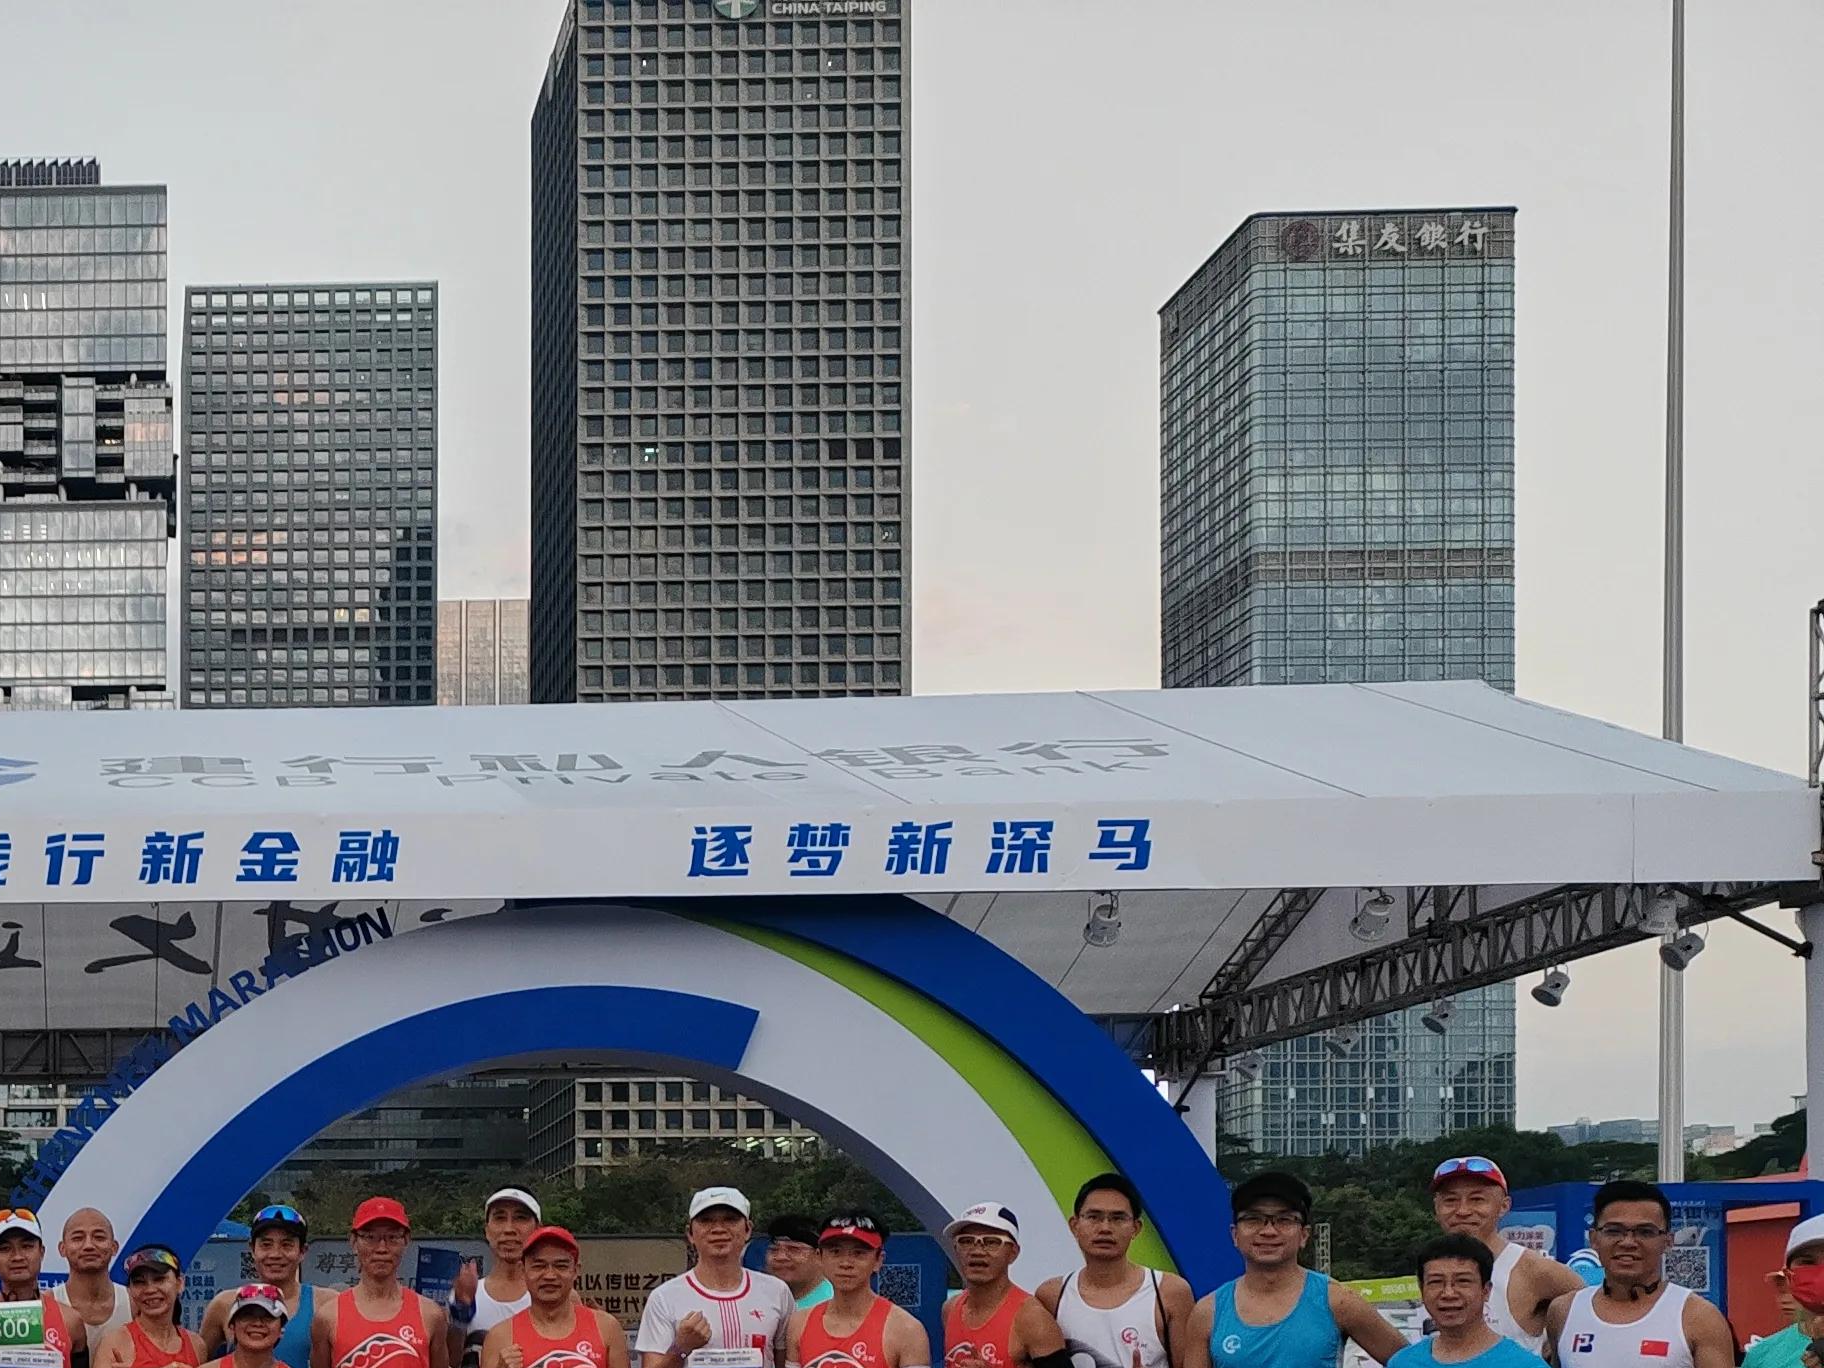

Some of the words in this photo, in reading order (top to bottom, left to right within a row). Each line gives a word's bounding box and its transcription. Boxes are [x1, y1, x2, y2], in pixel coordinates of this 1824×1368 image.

[772, 2, 821, 15] CHINA
[825, 1, 888, 14] TAIPING
[1332, 219, 1489, 256] 集友銀行
[100, 737, 1171, 777] 建行私人银行
[107, 774, 338, 789] CCB
[438, 770, 808, 787] Private
[867, 758, 1154, 781] Bank
[687, 818, 1153, 878] 逐梦新深马
